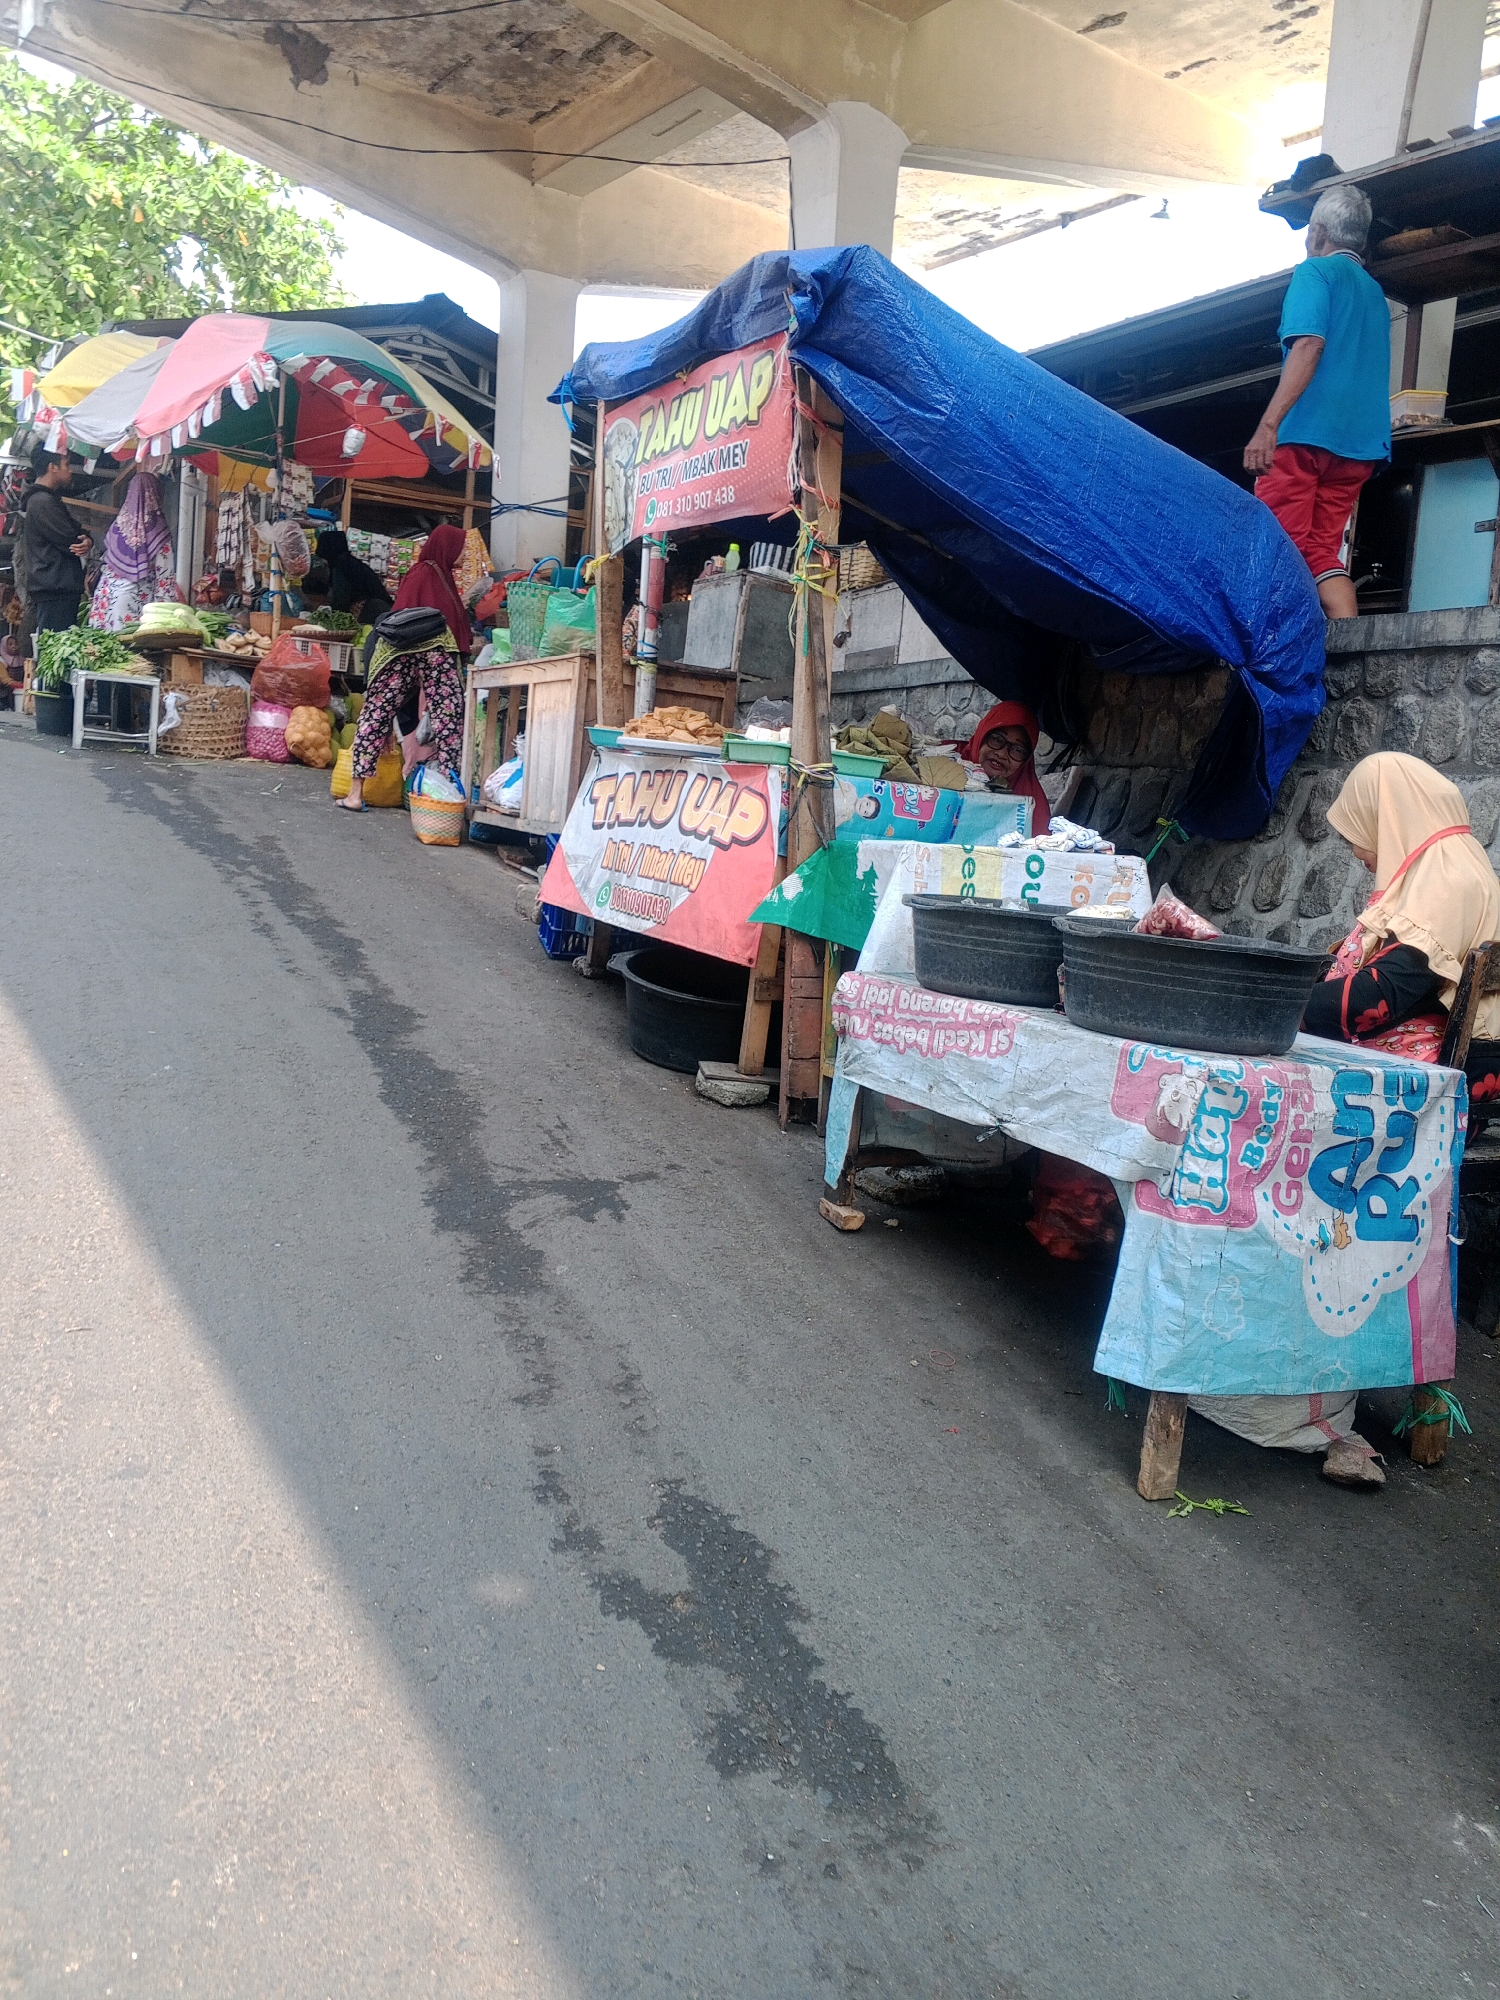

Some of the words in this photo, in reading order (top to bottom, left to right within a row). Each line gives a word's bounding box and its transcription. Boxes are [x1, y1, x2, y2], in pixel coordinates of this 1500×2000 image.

[634, 385, 704, 467] TAHU
[704, 351, 775, 440] UAP
[639, 472, 654, 496] BU
[654, 467, 673, 488] TRI
[682, 449, 715, 481] MBAK
[719, 441, 749, 471] MEY
[656, 501, 672, 517] 081
[676, 495, 691, 514] 310
[694, 491, 712, 509] 907
[715, 487, 735, 504] 438
[590, 769, 687, 830] TAHU
[679, 774, 769, 851] UAP
[860, 983, 896, 1015] jadi
[873, 1021, 930, 1051] bebas
[933, 1027, 985, 1054] Kecil
